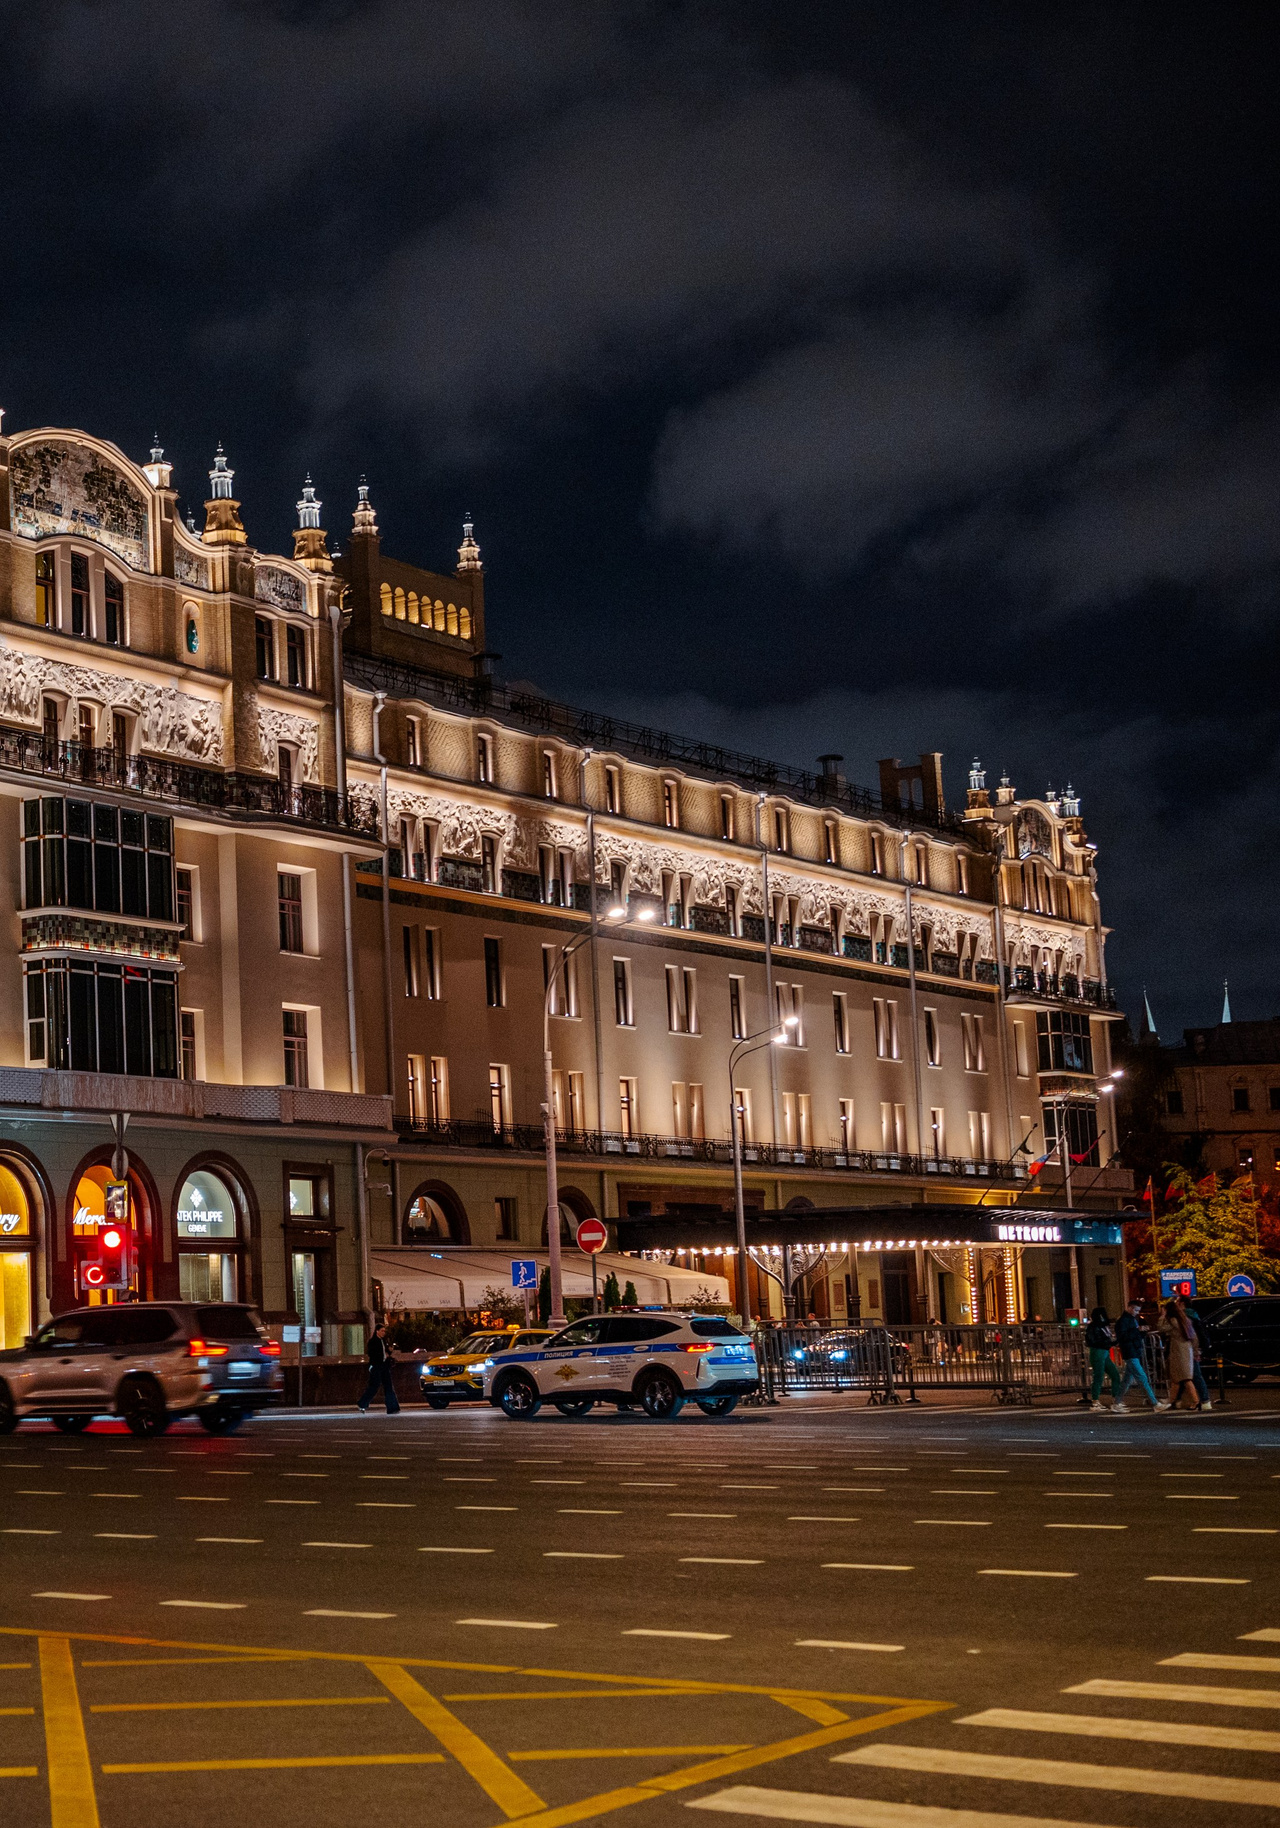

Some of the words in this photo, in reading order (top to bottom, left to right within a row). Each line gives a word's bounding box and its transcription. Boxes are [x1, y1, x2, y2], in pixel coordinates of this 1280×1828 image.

[73, 1207, 112, 1226] Merc
[177, 1210, 192, 1222] ATEK
[192, 1210, 223, 1223] PHILIPPE
[998, 1225, 1062, 1241] METROPOL
[544, 1351, 574, 1359] ПОЛИЦИЯ
